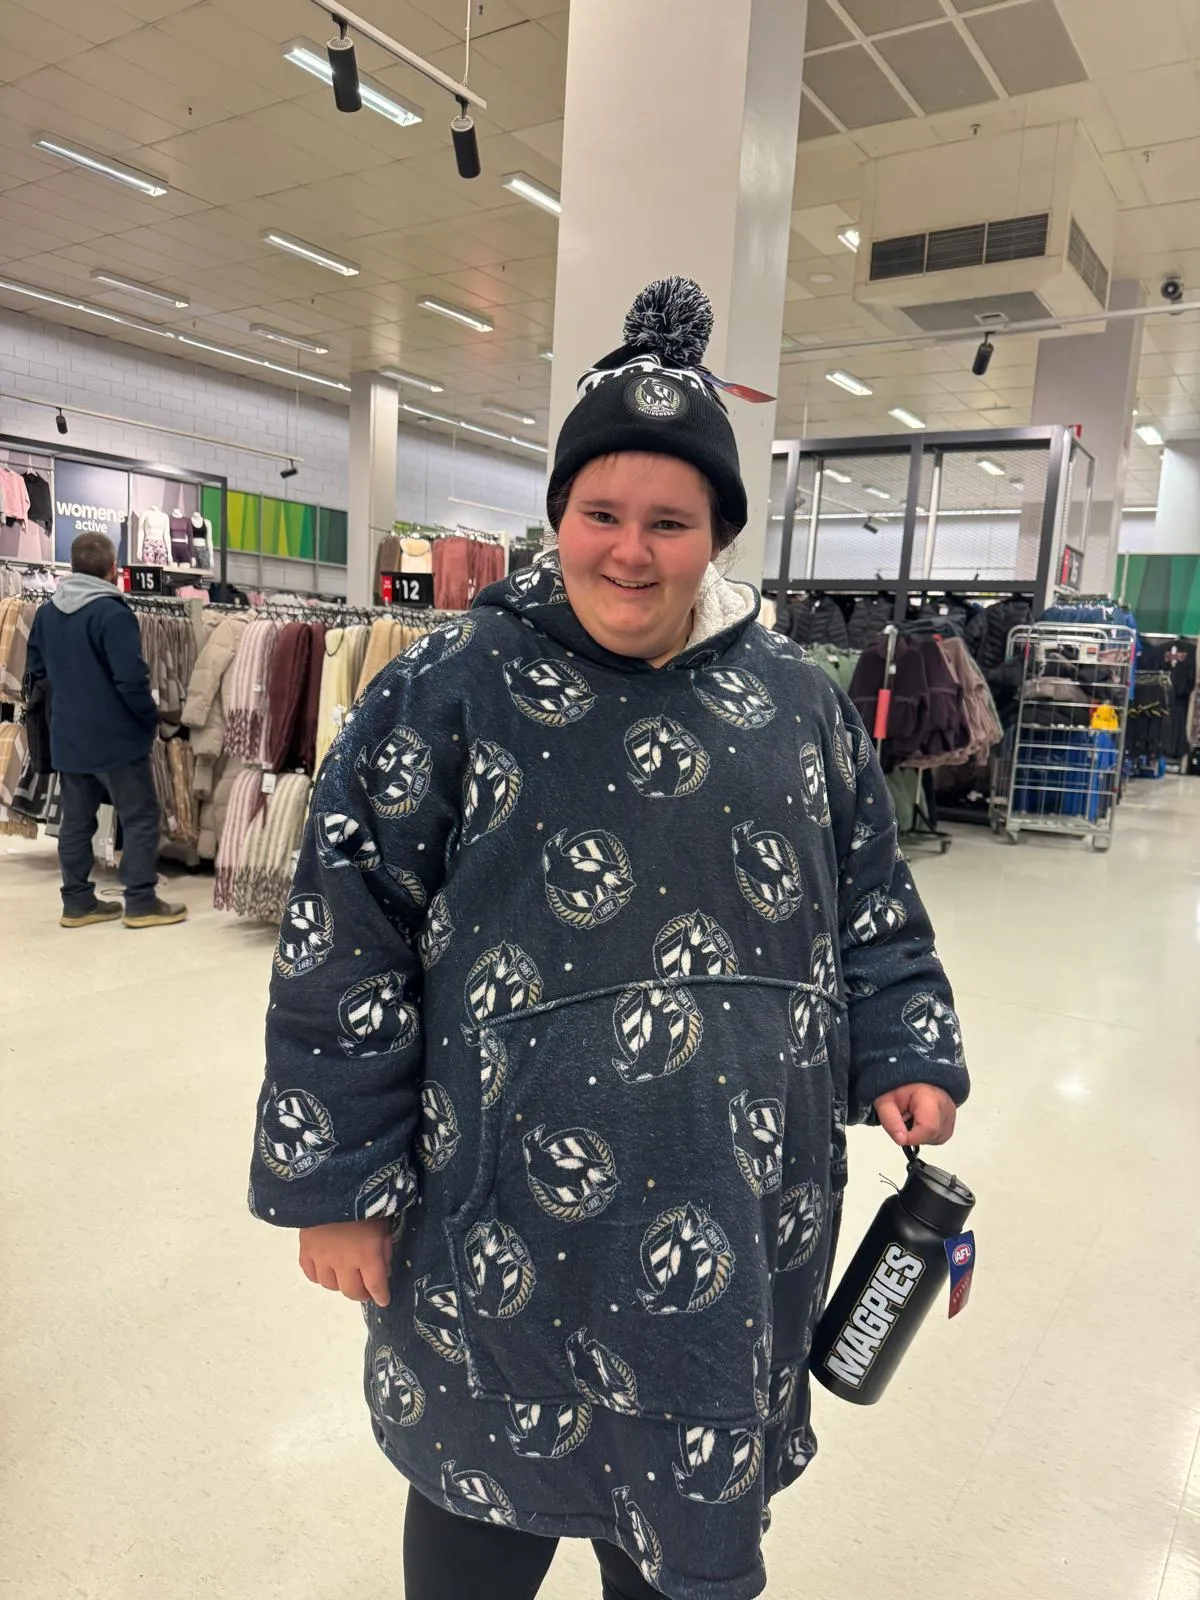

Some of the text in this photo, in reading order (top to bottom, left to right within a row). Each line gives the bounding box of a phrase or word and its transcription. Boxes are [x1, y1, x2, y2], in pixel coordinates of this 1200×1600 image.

[56, 501, 126, 524] womens
[75, 517, 108, 533] active
[136, 572, 154, 590] $15
[396, 579, 420, 600] $12
[411, 774, 425, 794] 1892
[599, 900, 616, 918] 1892
[713, 934, 728, 952] 1892
[297, 956, 316, 971] 1892
[518, 961, 533, 978] 1892
[675, 990, 691, 1008] 1892
[295, 1156, 314, 1173] 1892
[706, 1229, 722, 1248] 1892
[511, 1242, 526, 1260] 1892
[954, 1245, 972, 1262] AFL
[824, 1243, 925, 1388] MAGPIES
[402, 1371, 415, 1386] 1892
